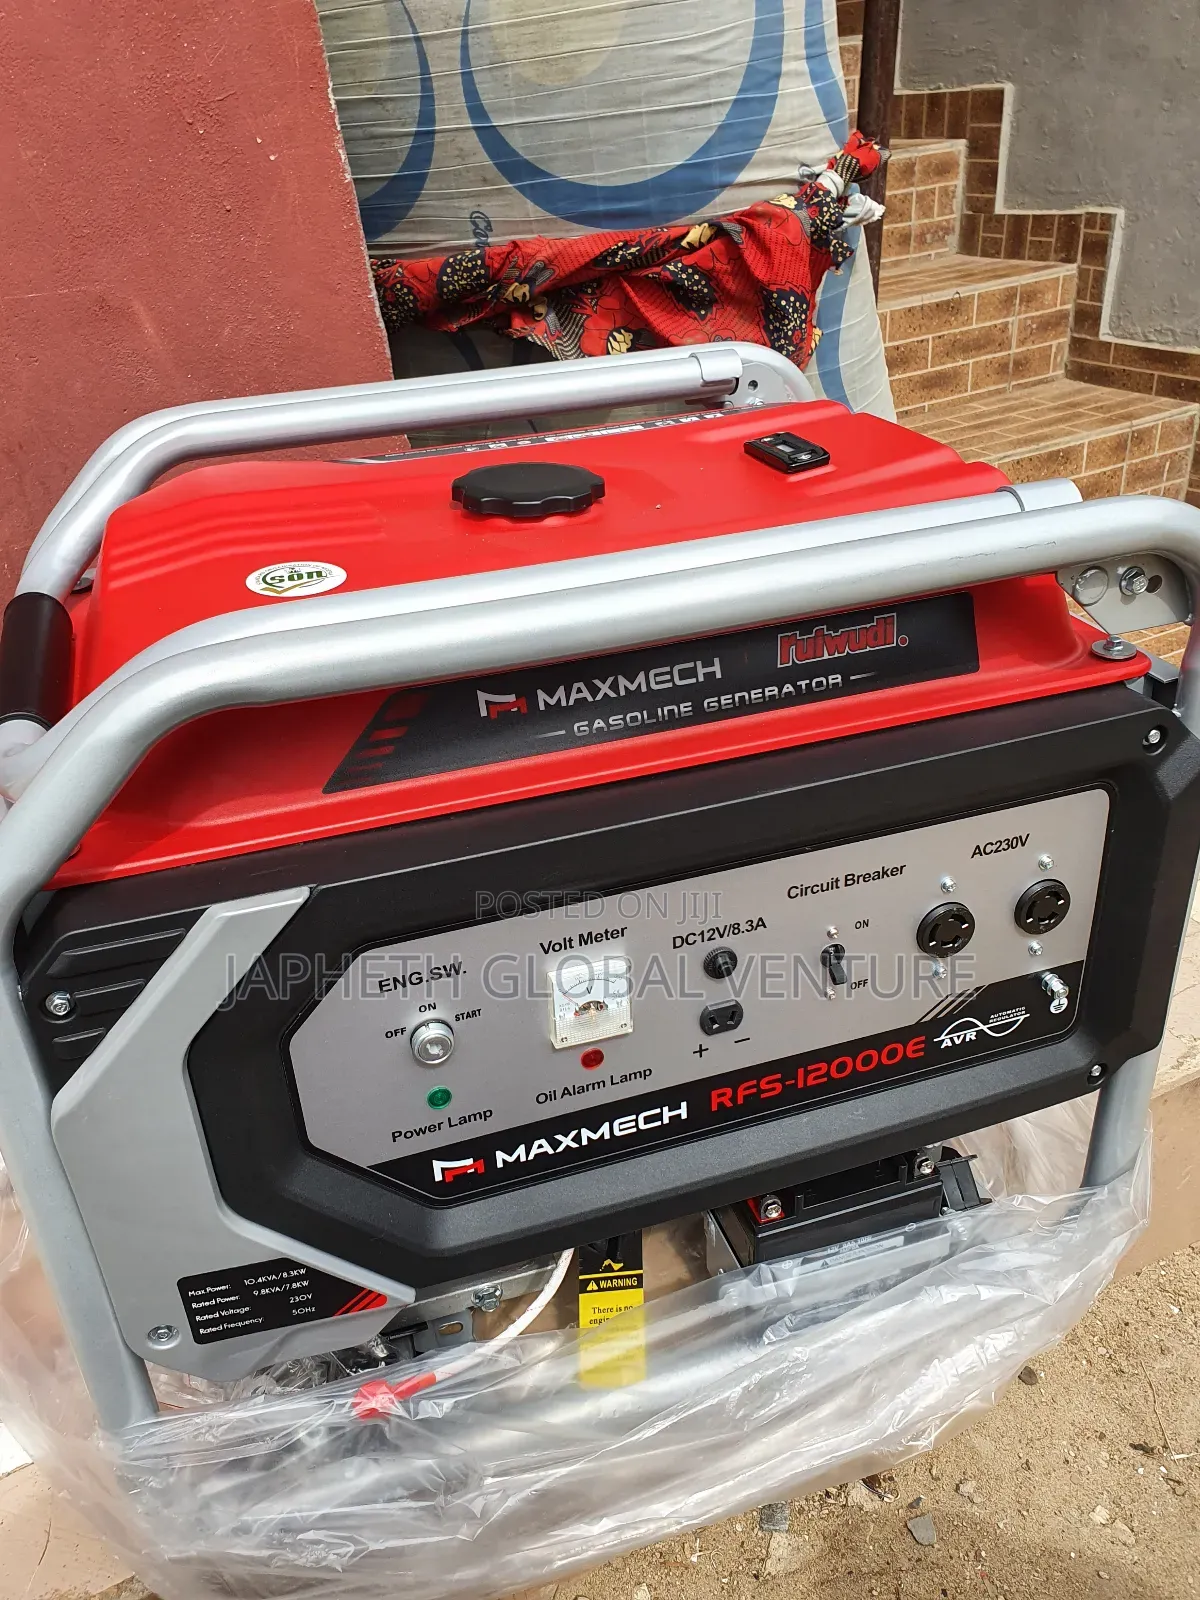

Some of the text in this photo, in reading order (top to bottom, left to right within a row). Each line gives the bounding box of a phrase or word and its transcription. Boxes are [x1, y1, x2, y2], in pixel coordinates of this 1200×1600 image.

[538, 658, 722, 711] MAXMECH
[573, 673, 843, 736] GASOLINE GENERATOR
[971, 833, 1031, 859] AC230V
[786, 863, 907, 900] Circuit Breaker
[671, 917, 767, 950] DC12V/8.3A
[854, 919, 870, 930] ON
[539, 924, 628, 956] Volt Meter
[378, 961, 468, 994] ENG.SW.
[850, 978, 869, 991] OFF
[418, 1002, 437, 1013] ON
[454, 1008, 482, 1022] START
[988, 1010, 1026, 1024] REGULATOR
[989, 1006, 1026, 1019] AUTOMATIC
[384, 1027, 407, 1040] OFF
[940, 1031, 977, 1049] AVR
[535, 1065, 653, 1106] Oil Alarm Lamp
[496, 1035, 927, 1169] MAXMECH RFS-12000E
[391, 1107, 494, 1143] Power Lamp
[244, 1268, 307, 1286] 10.4KVA/8.3KW
[600, 1277, 638, 1288] WARNING
[191, 1299, 216, 1310] Rated
[216, 1294, 241, 1305] Power:
[195, 1293, 313, 1322] Rated Voltage: 230V
[592, 1306, 614, 1315] There
[615, 1304, 622, 1313] is
[199, 1306, 316, 1335] Rated Frequency: 50Hz
